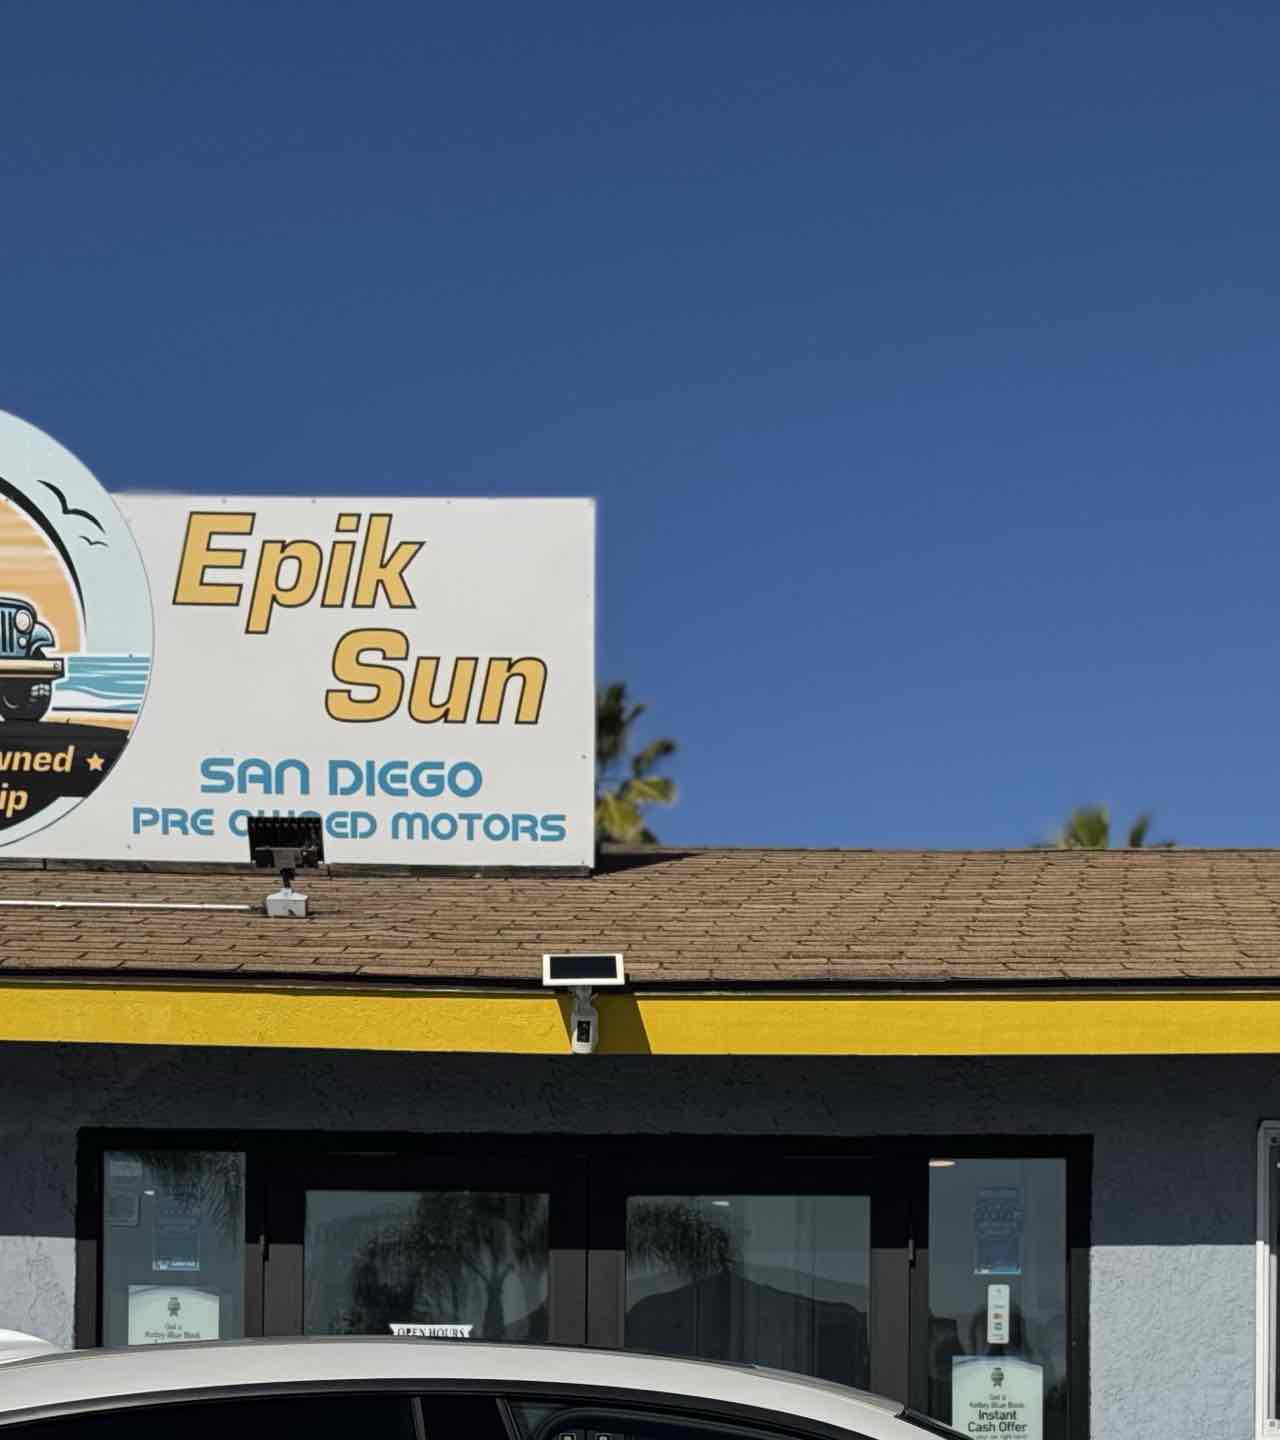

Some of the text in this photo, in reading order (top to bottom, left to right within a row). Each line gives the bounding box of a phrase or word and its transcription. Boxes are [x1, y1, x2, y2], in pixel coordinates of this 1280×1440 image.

[172, 511, 426, 634] Epik
[325, 627, 548, 724] Sun
[200, 757, 482, 797] SAN DIEGO
[132, 807, 567, 842] PRE OED MOTORS
[967, 1422, 1027, 1432] Cash Offer
[978, 1410, 1017, 1420] Instant
